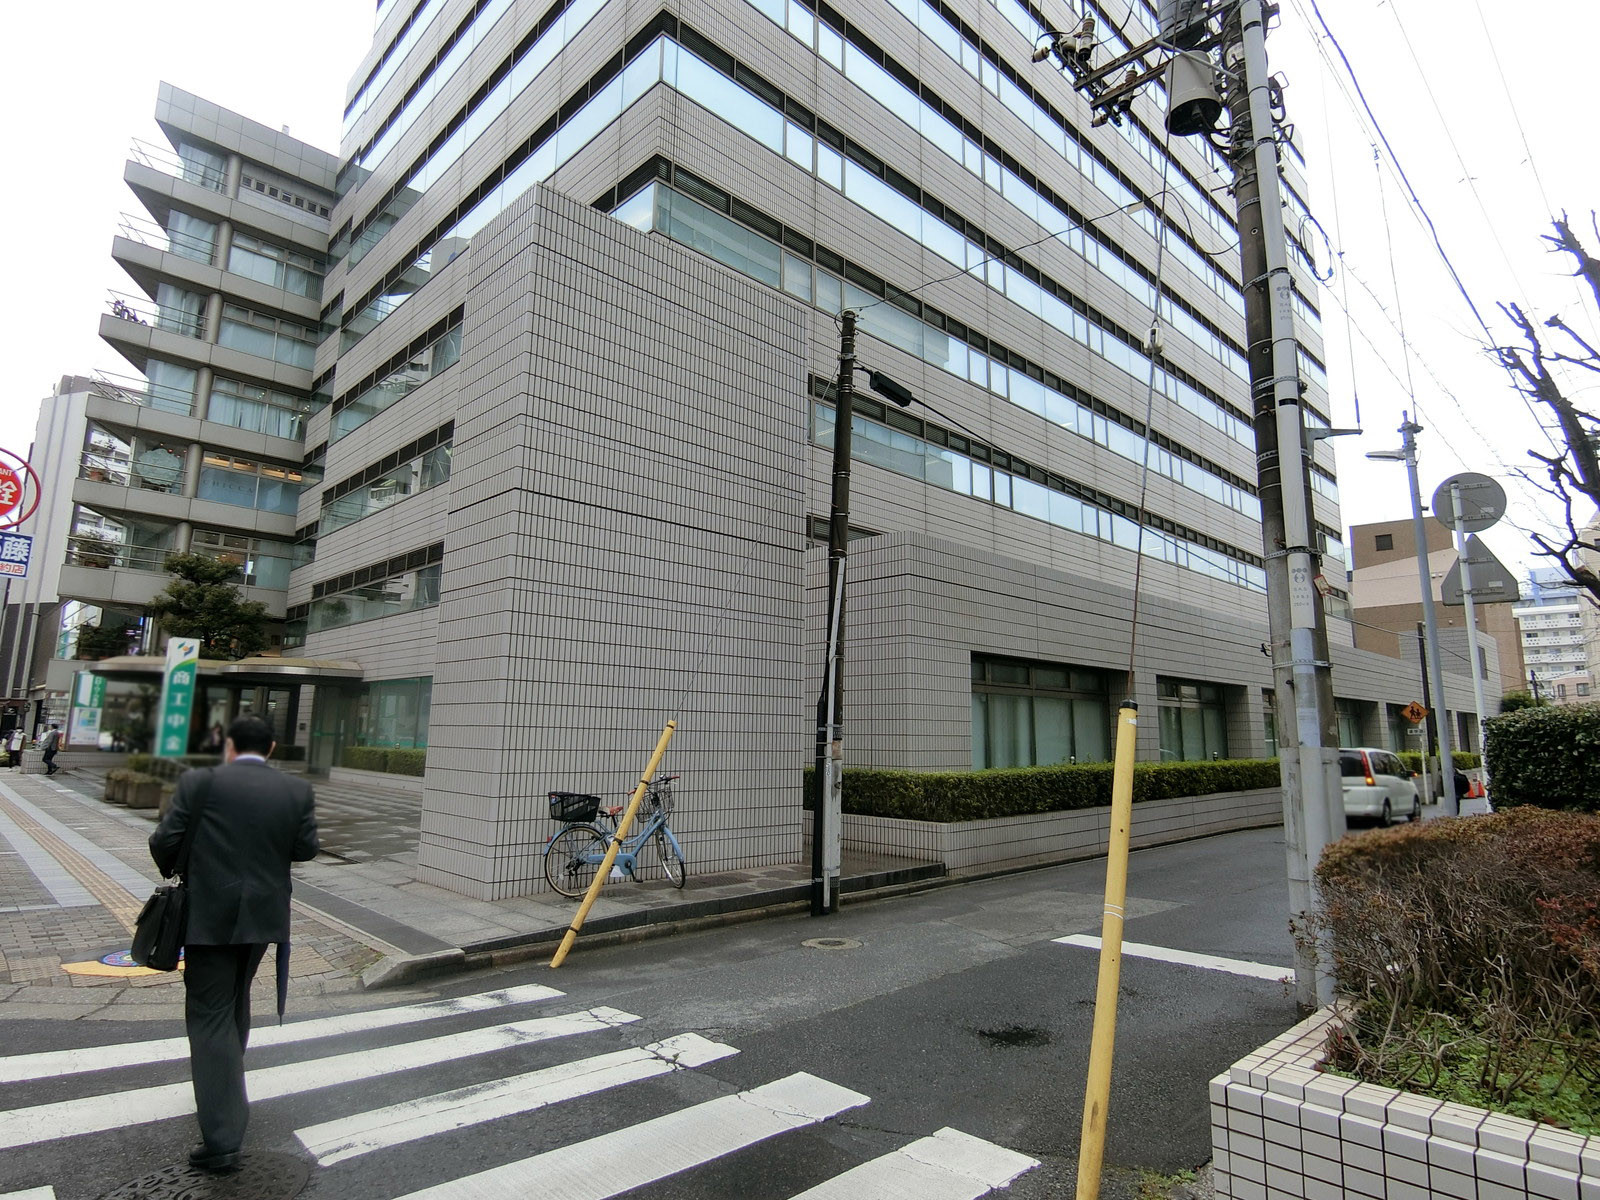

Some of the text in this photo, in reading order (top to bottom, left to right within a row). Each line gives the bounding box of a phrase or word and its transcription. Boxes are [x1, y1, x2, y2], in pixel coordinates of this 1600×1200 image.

[0, 534, 31, 562] 藤
[165, 670, 191, 751] 商工中金
